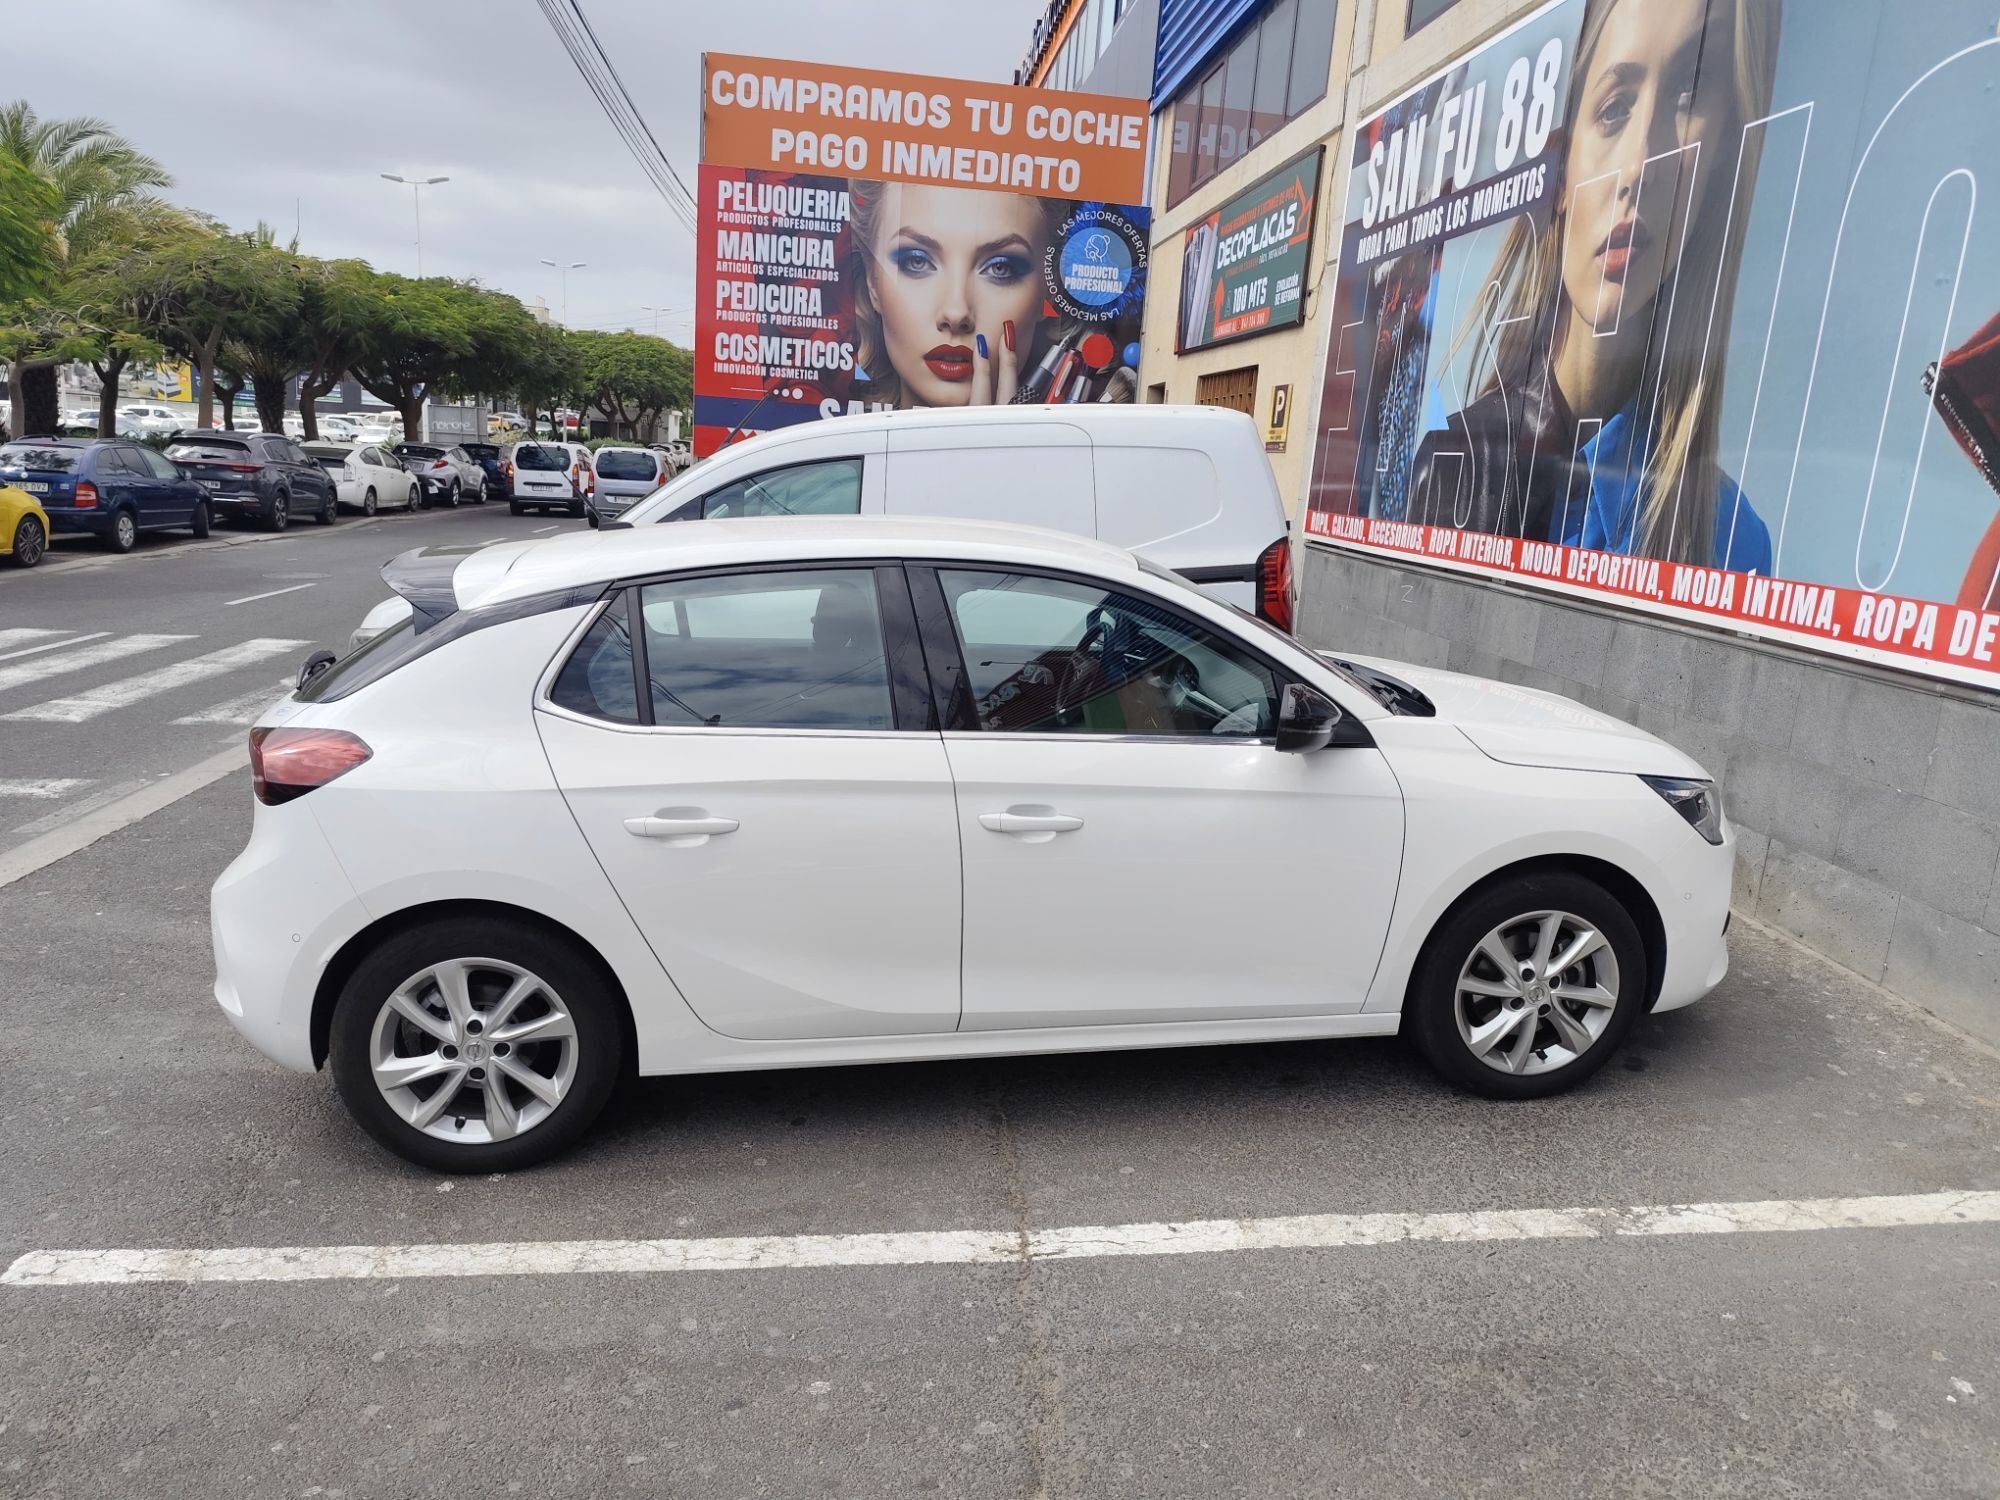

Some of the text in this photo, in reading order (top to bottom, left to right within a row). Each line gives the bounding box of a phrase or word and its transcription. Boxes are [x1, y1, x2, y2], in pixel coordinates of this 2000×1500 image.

[712, 70, 1143, 149] COMPRAMOS TU COCHE
[1362, 114, 1428, 229] SAN
[1431, 79, 1486, 200] FU
[1495, 38, 1562, 172] 88
[771, 128, 1080, 192] PAGO INMEDIATO
[718, 180, 850, 221] PELUQUERIA
[1357, 163, 1547, 264] MODA PARA TODOS LOS MOMENTOS
[717, 211, 842, 234] PRODUCTOS PROFESIONALES
[1057, 211, 1147, 268] LAS MEJORES OFERTAS
[1217, 202, 1297, 269] DECOPLACAS
[717, 230, 835, 268] MANICURA
[716, 260, 839, 282] ARTICULOS ESPECIALIZADOS
[1044, 246, 1120, 322] LAS MEJORES OFERTAS
[1064, 277, 1124, 294] PROFESIONAL
[1072, 264, 1119, 280] PRODUCTO
[716, 280, 822, 317] PEDICURA
[1233, 276, 1268, 314] 100 MTS
[716, 309, 839, 330] PRODUCTOS PROFESIONALES
[715, 332, 853, 371] COSMETICOS
[714, 362, 819, 381] INNOVACIÓN COSMETICA
[1274, 389, 1285, 424] P
[1310, 511, 2000, 663] ROPA, CALZADO, ACCESORIOS, ROPA INTERIOR, MODA DEPORTIVA, MODA ÍNTIMA, ROPA DE
